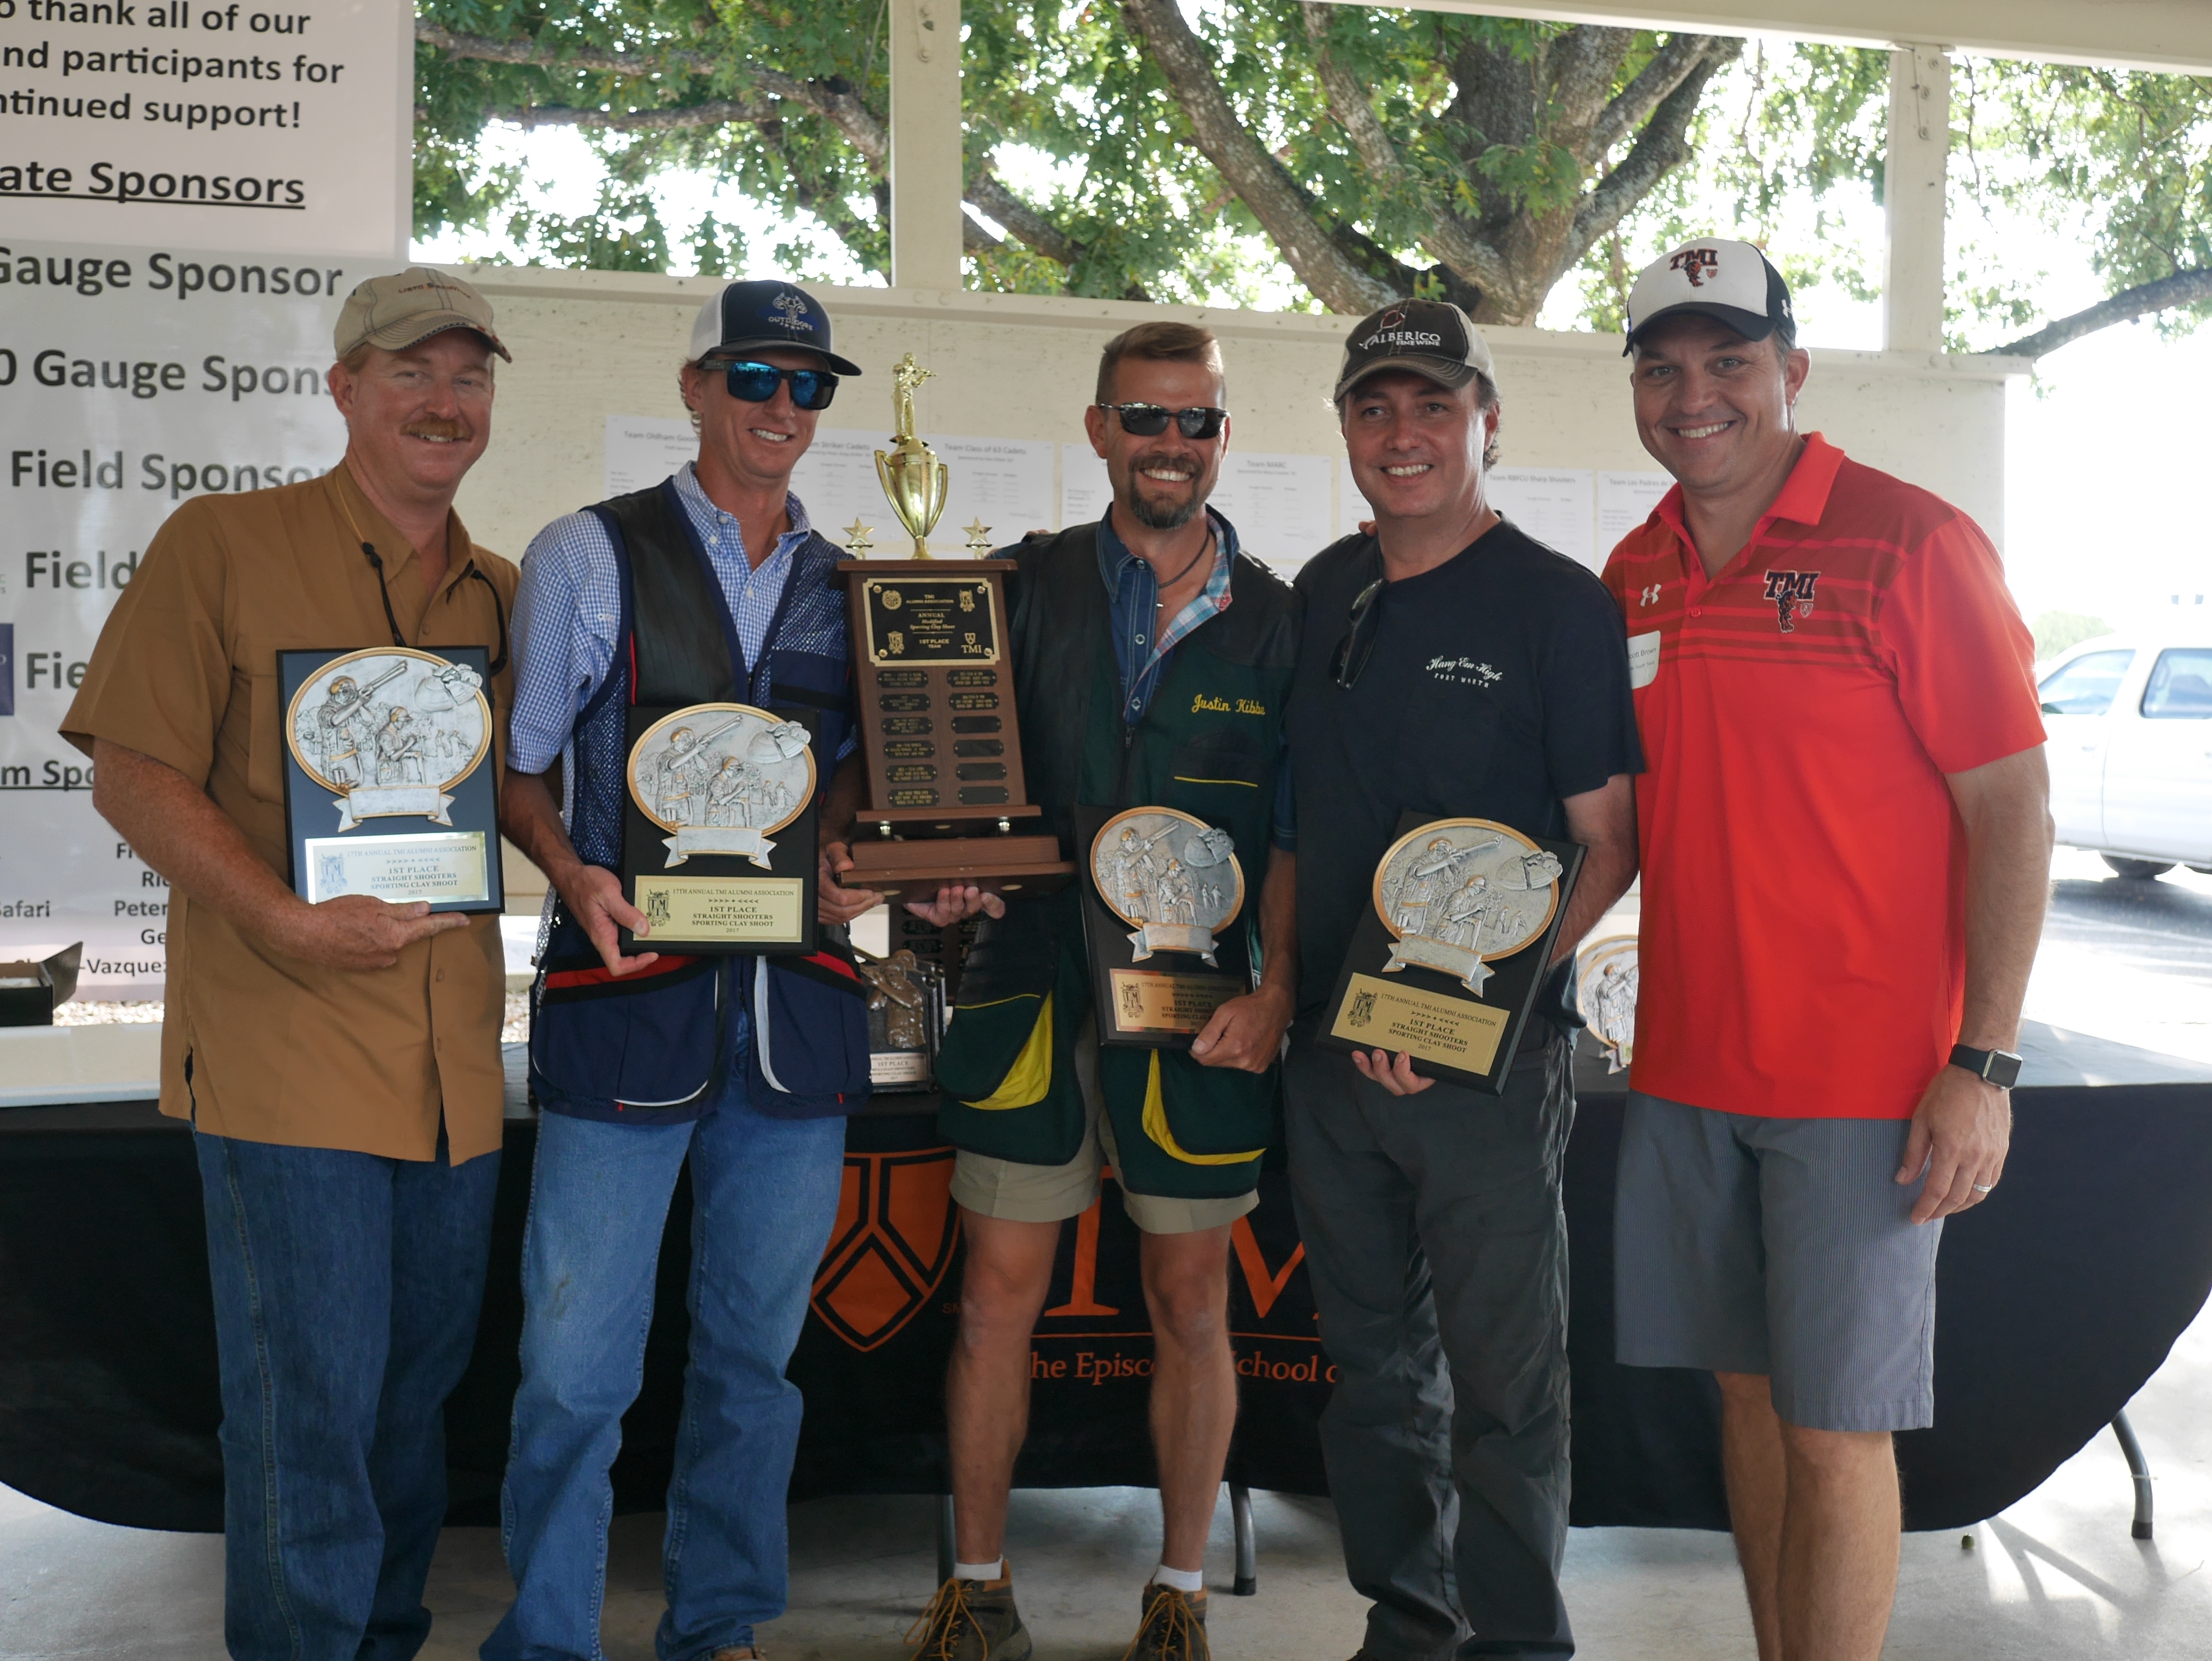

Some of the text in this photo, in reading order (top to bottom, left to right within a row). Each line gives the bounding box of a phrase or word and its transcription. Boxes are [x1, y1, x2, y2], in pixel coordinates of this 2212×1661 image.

[29, 0, 135, 26] thank
[148, 1, 189, 28] all
[201, 4, 239, 31] of
[249, 13, 311, 34] our
[63, 47, 281, 82] participants
[293, 55, 344, 83] for
[144, 101, 301, 131] support!
[89, 162, 304, 203] Sponsors
[1670, 249, 1718, 271] TMI
[148, 253, 342, 299] Sponsor
[1364, 331, 1441, 347] ALBERICO
[33, 350, 186, 399] Gauge
[12, 449, 334, 499] Field Sponso
[26, 551, 137, 589] Field
[1764, 569, 1821, 602] TMI
[961, 645, 982, 654] TMI
[1426, 655, 1457, 672] Hang
[1461, 677, 1489, 688] WORTH
[1191, 694, 1231, 713] Justin
[434, 845, 477, 854] ASSOCIATION
[0, 900, 50, 918] afari
[1381, 993, 1395, 1002] 17TH
[1396, 996, 1420, 1007] ANNUAL
[1433, 1006, 1457, 1016] ALUMNI
[1457, 1012, 1497, 1027] ASSOCIATION
[1392, 1022, 1468, 1046] STRAIGHT SHOOTERS
[1410, 1018, 1455, 1035] 1ST PLACE
[1389, 1028, 1467, 1053] SPORTING CLAY SHOOT
[1074, 1352, 1156, 1386] Episc
[1231, 1350, 1318, 1382] chool
